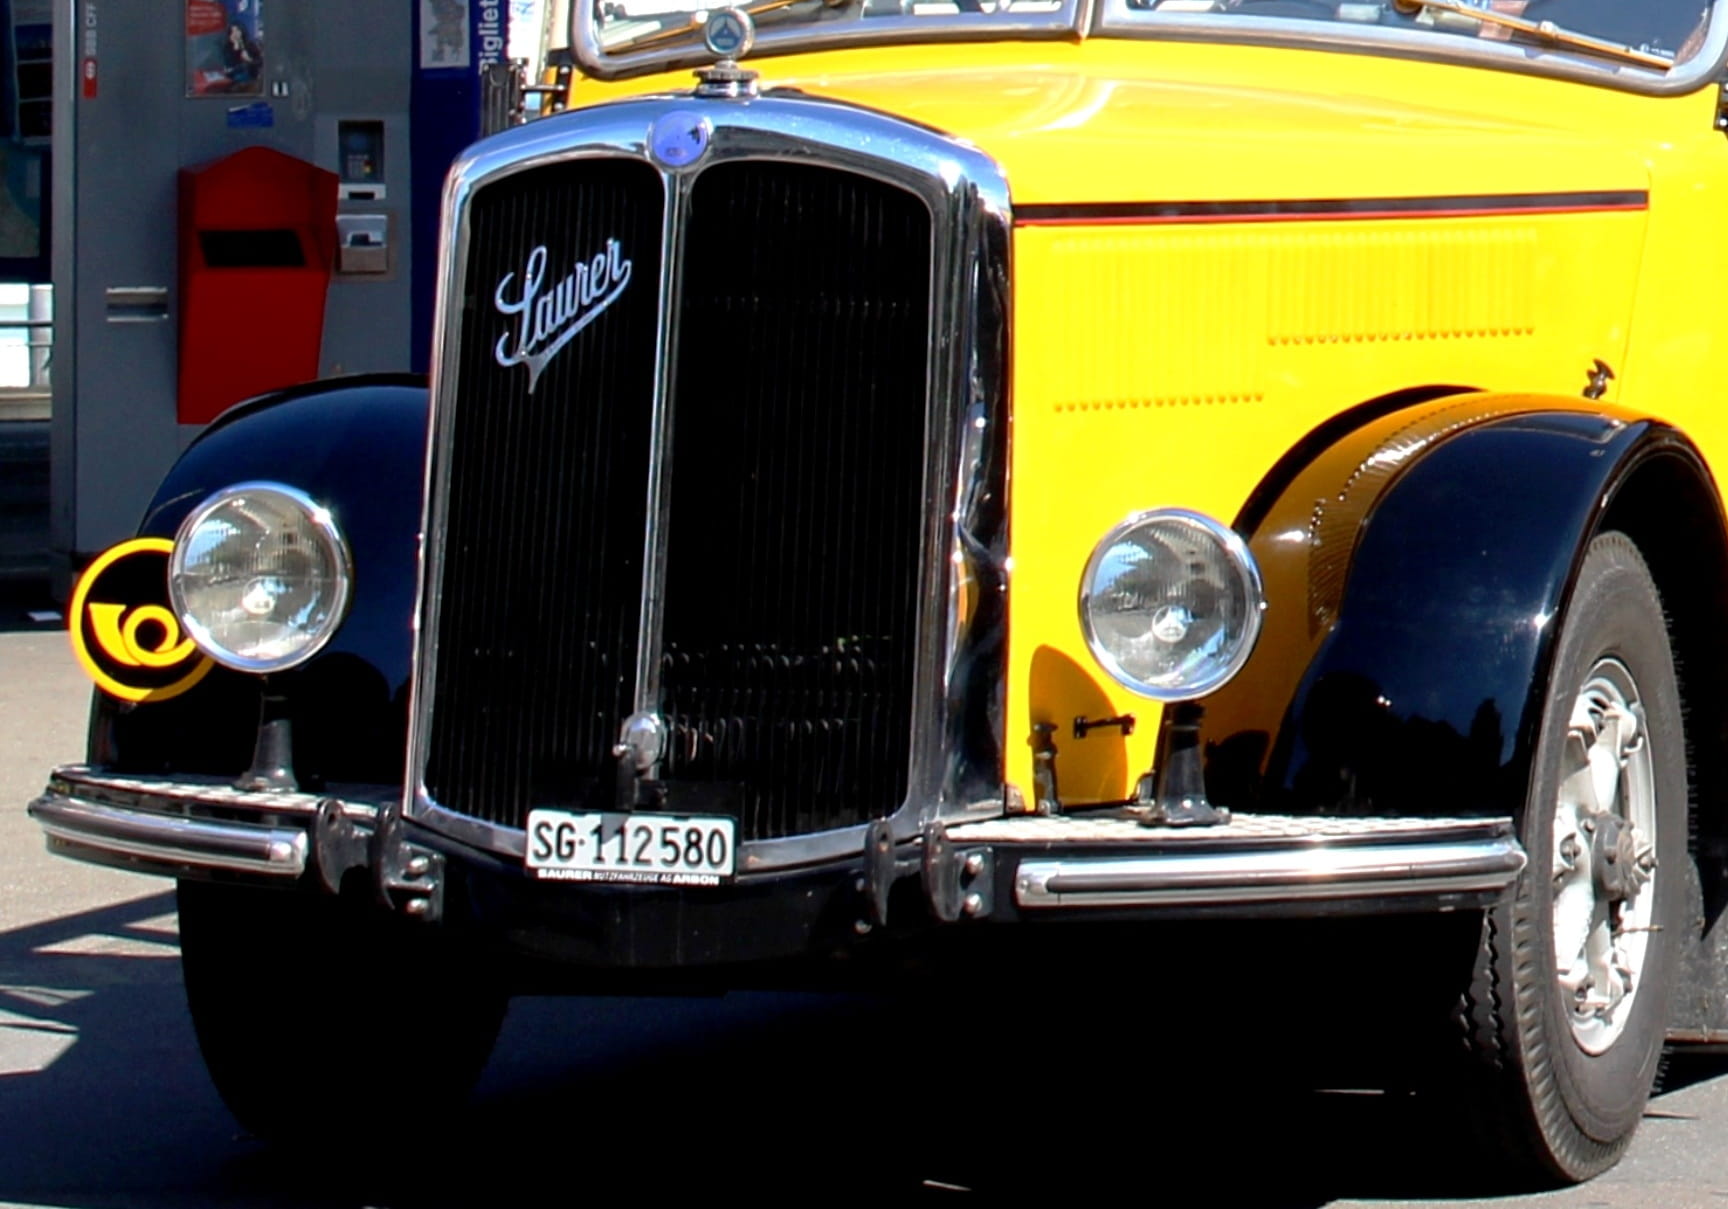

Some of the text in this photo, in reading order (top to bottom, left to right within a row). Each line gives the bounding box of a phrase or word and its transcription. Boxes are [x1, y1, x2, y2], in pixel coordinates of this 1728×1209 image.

[495, 238, 632, 394] Saurer
[537, 868, 592, 880] SAURER
[660, 874, 671, 883] AG
[672, 874, 720, 886] ARBON
